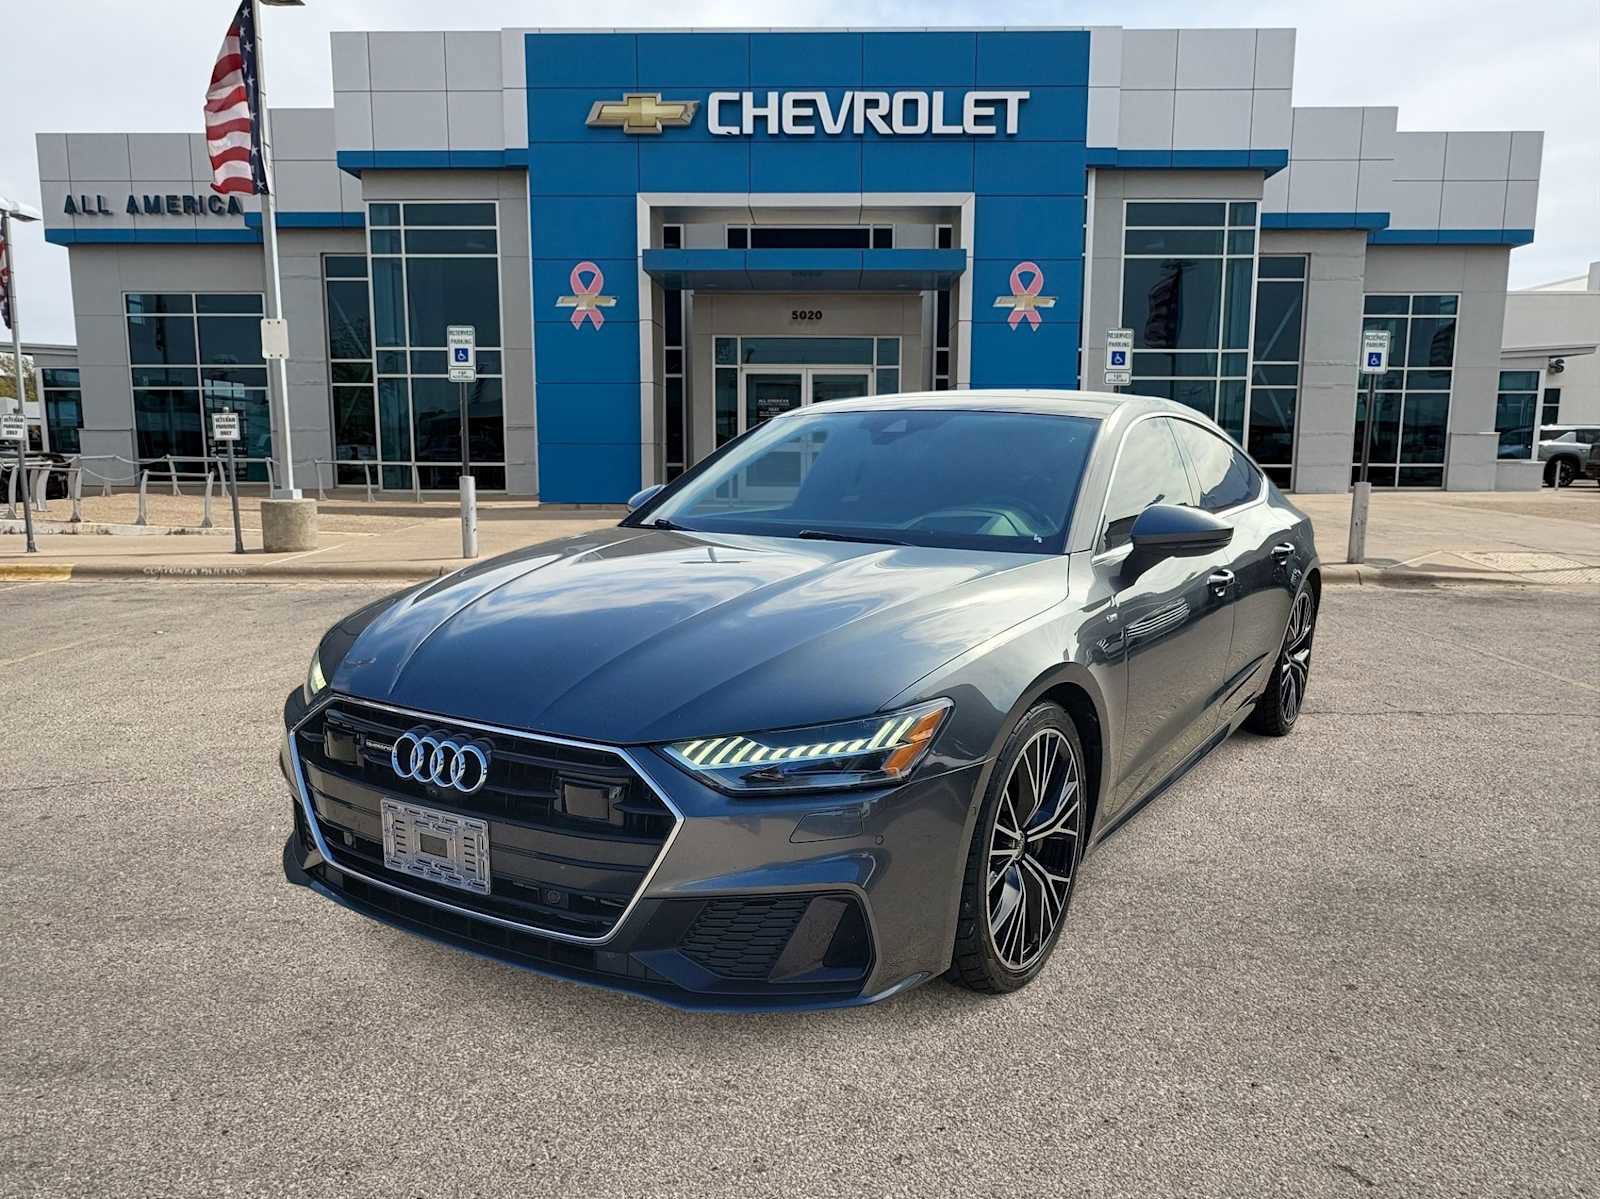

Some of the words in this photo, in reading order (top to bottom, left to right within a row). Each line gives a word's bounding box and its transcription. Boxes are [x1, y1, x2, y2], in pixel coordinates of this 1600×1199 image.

[707, 90, 1031, 136] CHEVROLET
[63, 194, 113, 216] ALL
[791, 310, 823, 320] 5020
